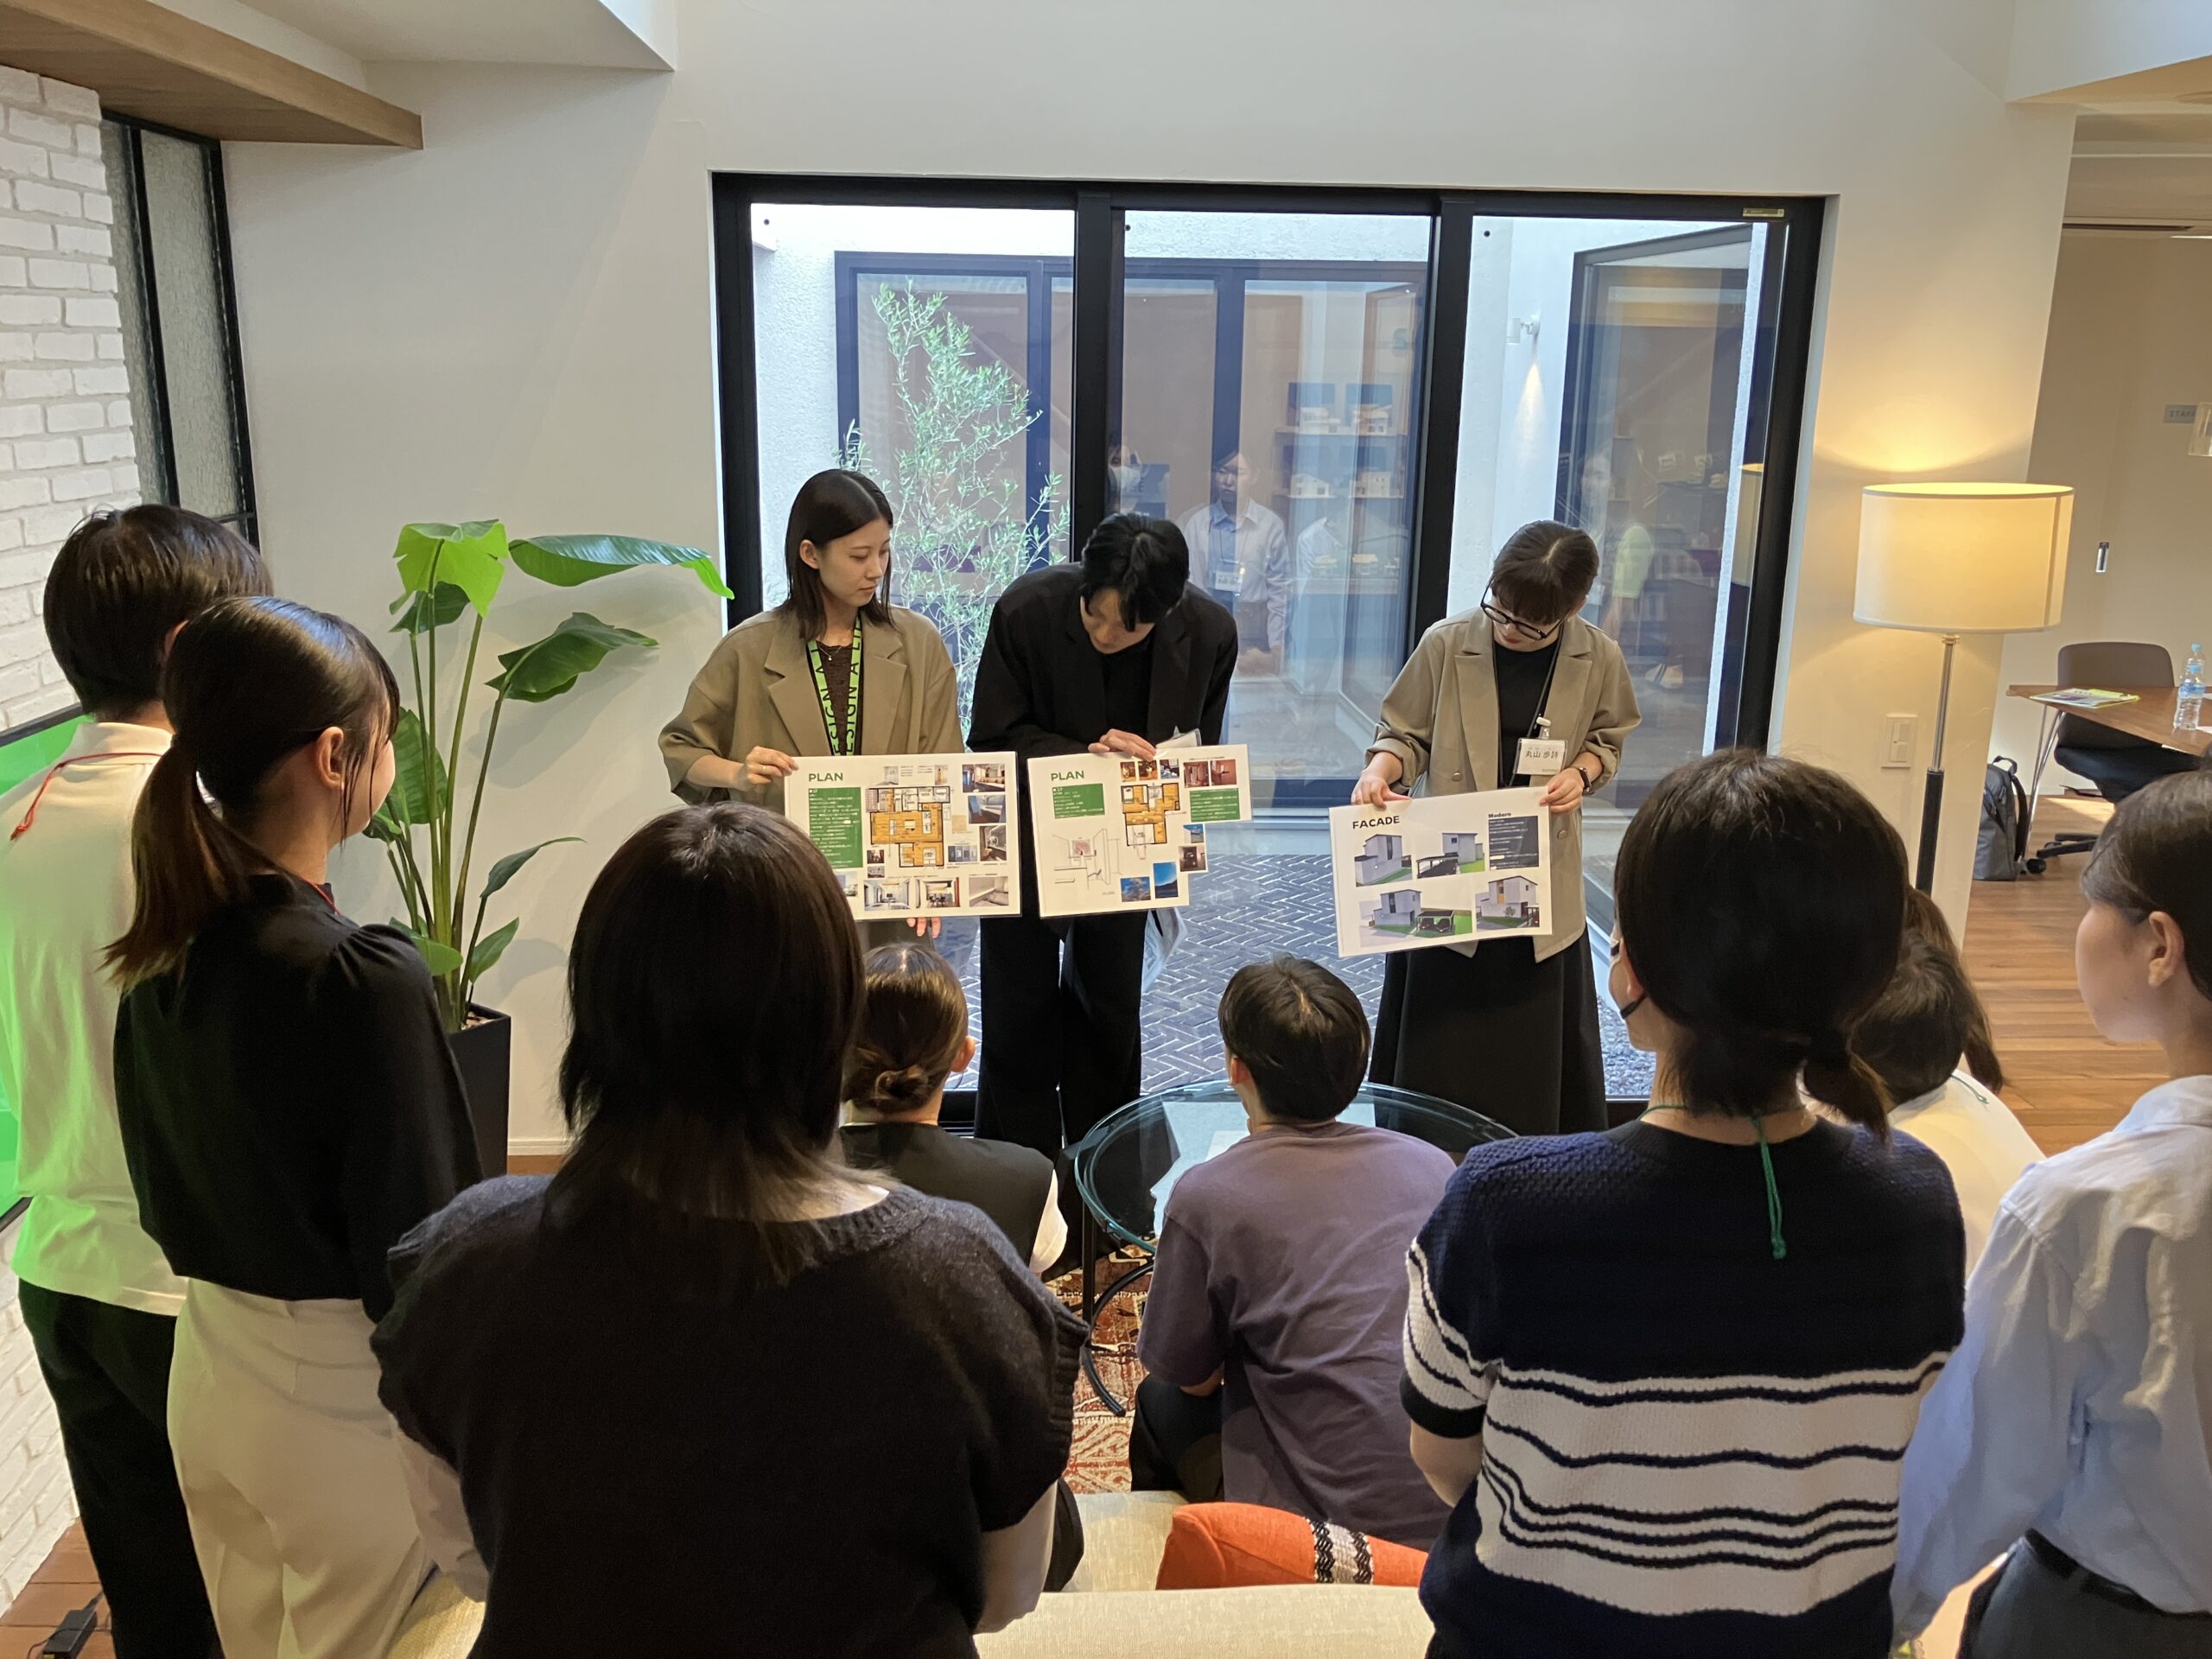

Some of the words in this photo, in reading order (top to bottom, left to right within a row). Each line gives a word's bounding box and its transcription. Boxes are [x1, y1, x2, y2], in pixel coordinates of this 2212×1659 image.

[809, 772, 843, 782] PLAN
[1051, 770, 1084, 781] PLAN
[1352, 815, 1401, 830] FACADE
